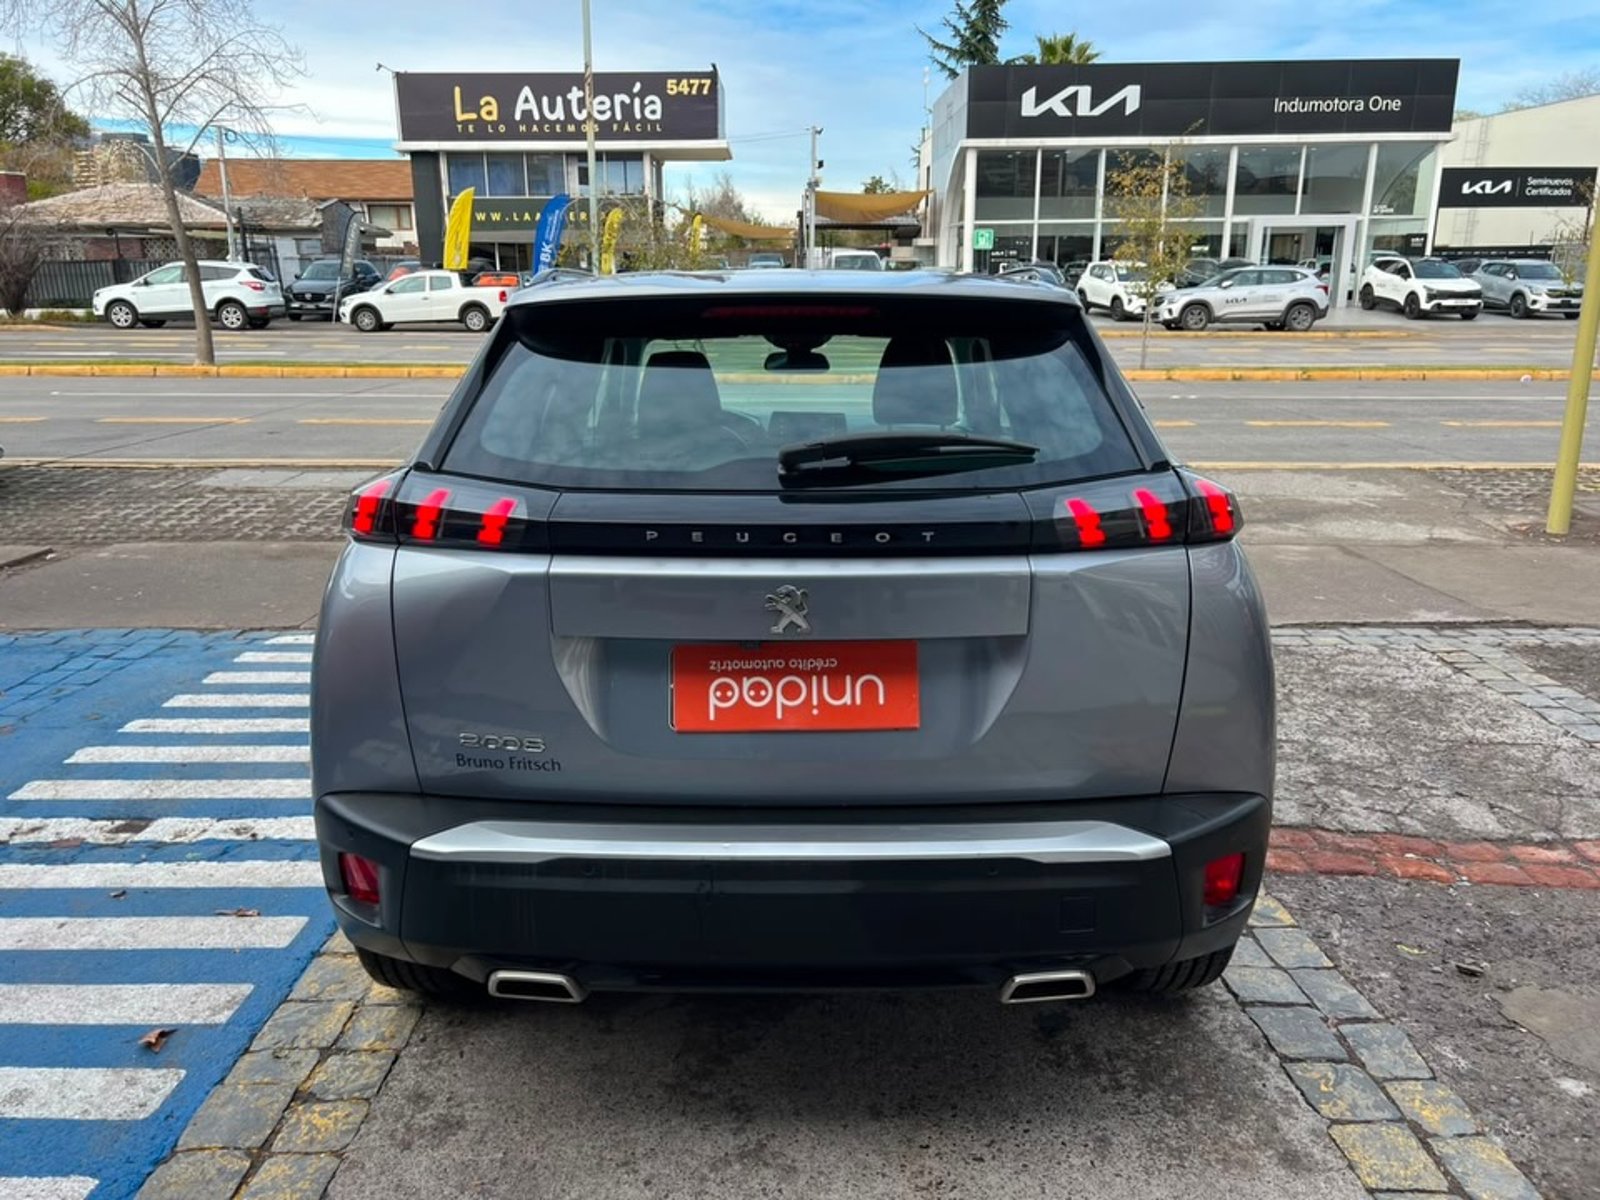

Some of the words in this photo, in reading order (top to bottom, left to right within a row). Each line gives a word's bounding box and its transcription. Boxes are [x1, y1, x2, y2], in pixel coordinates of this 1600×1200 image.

[666, 79, 712, 96] 5477
[454, 86, 498, 122] La
[514, 82, 662, 121] Autería
[1020, 84, 1141, 117] KIA
[1274, 97, 1365, 113] Indumotora
[1368, 95, 1402, 112] One
[456, 124, 475, 133] TE
[488, 124, 506, 133] LO
[519, 124, 600, 133] HACEMOS
[612, 122, 662, 133] FÁCIL
[1461, 180, 1513, 194] KIA
[1527, 176, 1574, 186] Seminuevos
[1525, 187, 1572, 196] Certificados
[645, 530, 935, 543] PEUGEOT
[709, 658, 785, 671] automotriz
[788, 658, 838, 671] crédito
[708, 674, 885, 721] unidad
[459, 732, 546, 753] 2008
[456, 753, 504, 769] Bruno
[508, 756, 561, 771] Fritsch
